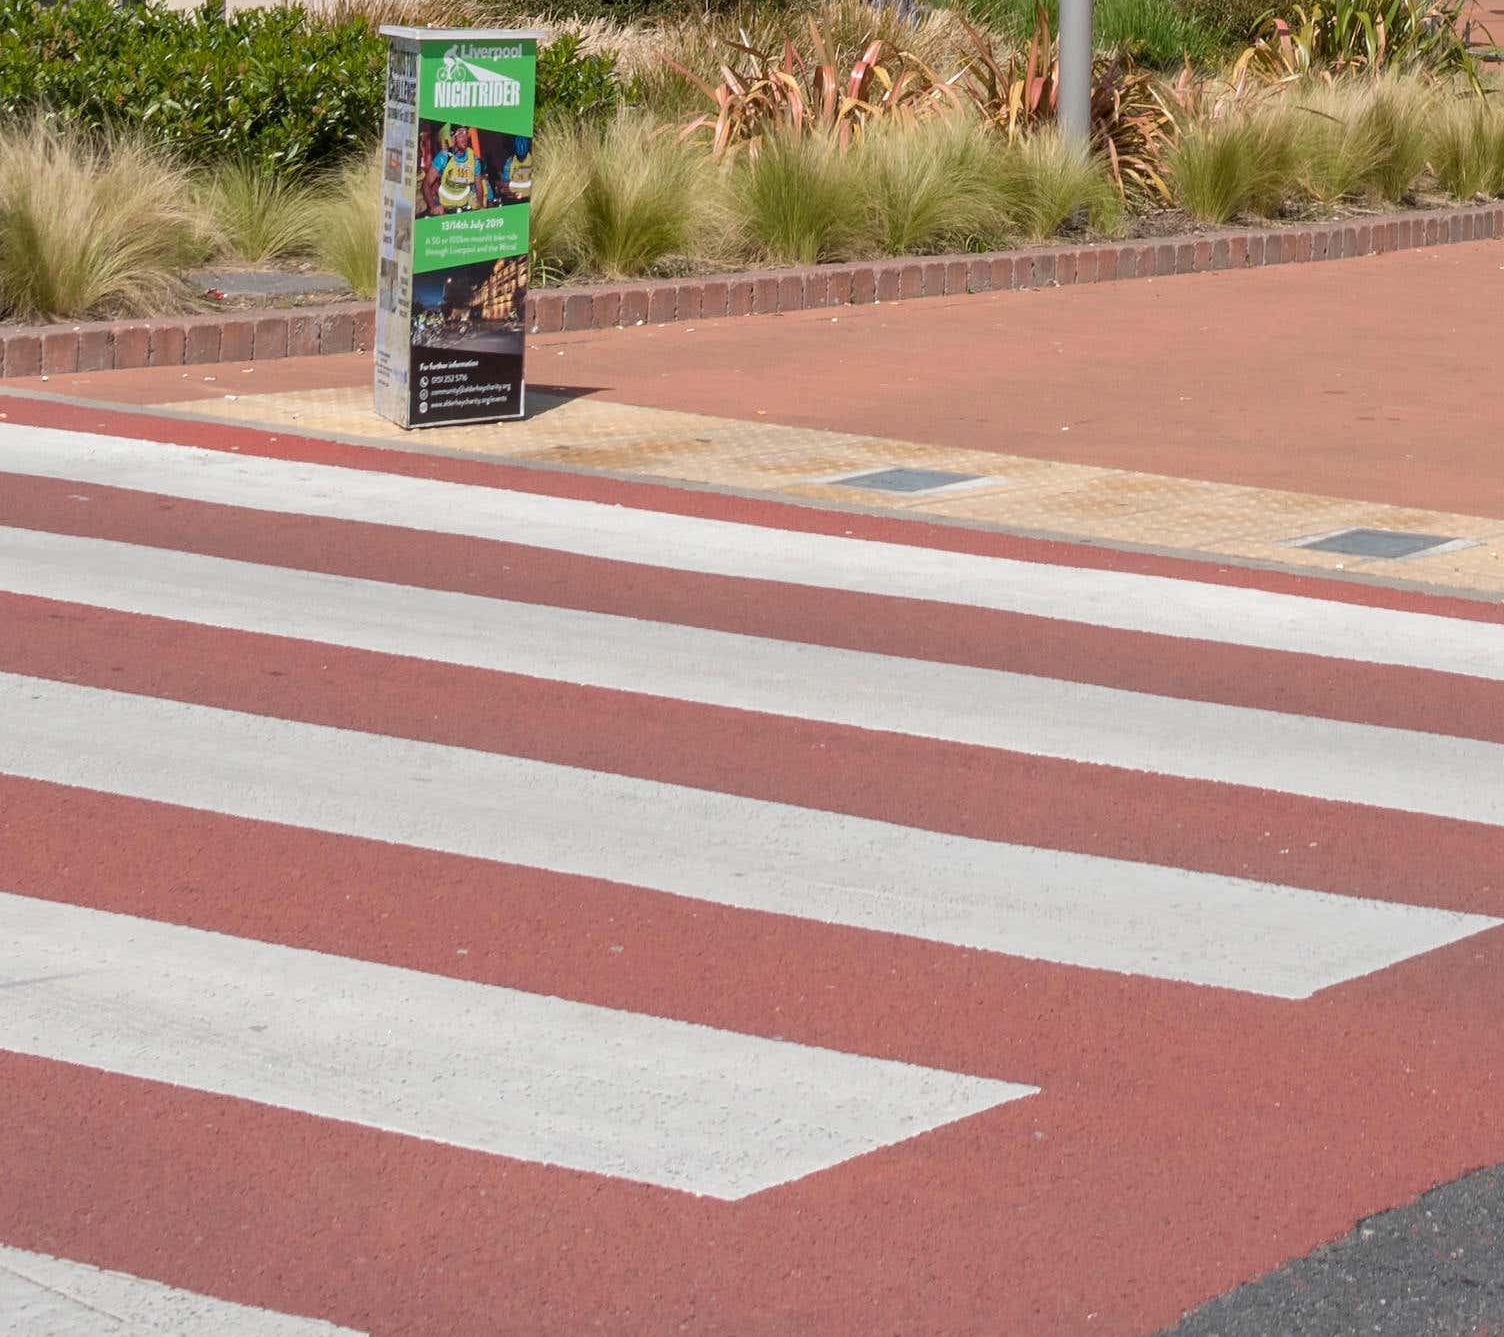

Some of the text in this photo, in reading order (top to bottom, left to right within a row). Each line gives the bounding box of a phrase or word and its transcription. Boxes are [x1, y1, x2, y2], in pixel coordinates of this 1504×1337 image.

[460, 43, 523, 61] Liverpool
[433, 80, 521, 108] NIGHTRIDER
[469, 219, 485, 232] July
[486, 217, 504, 229] 2019
